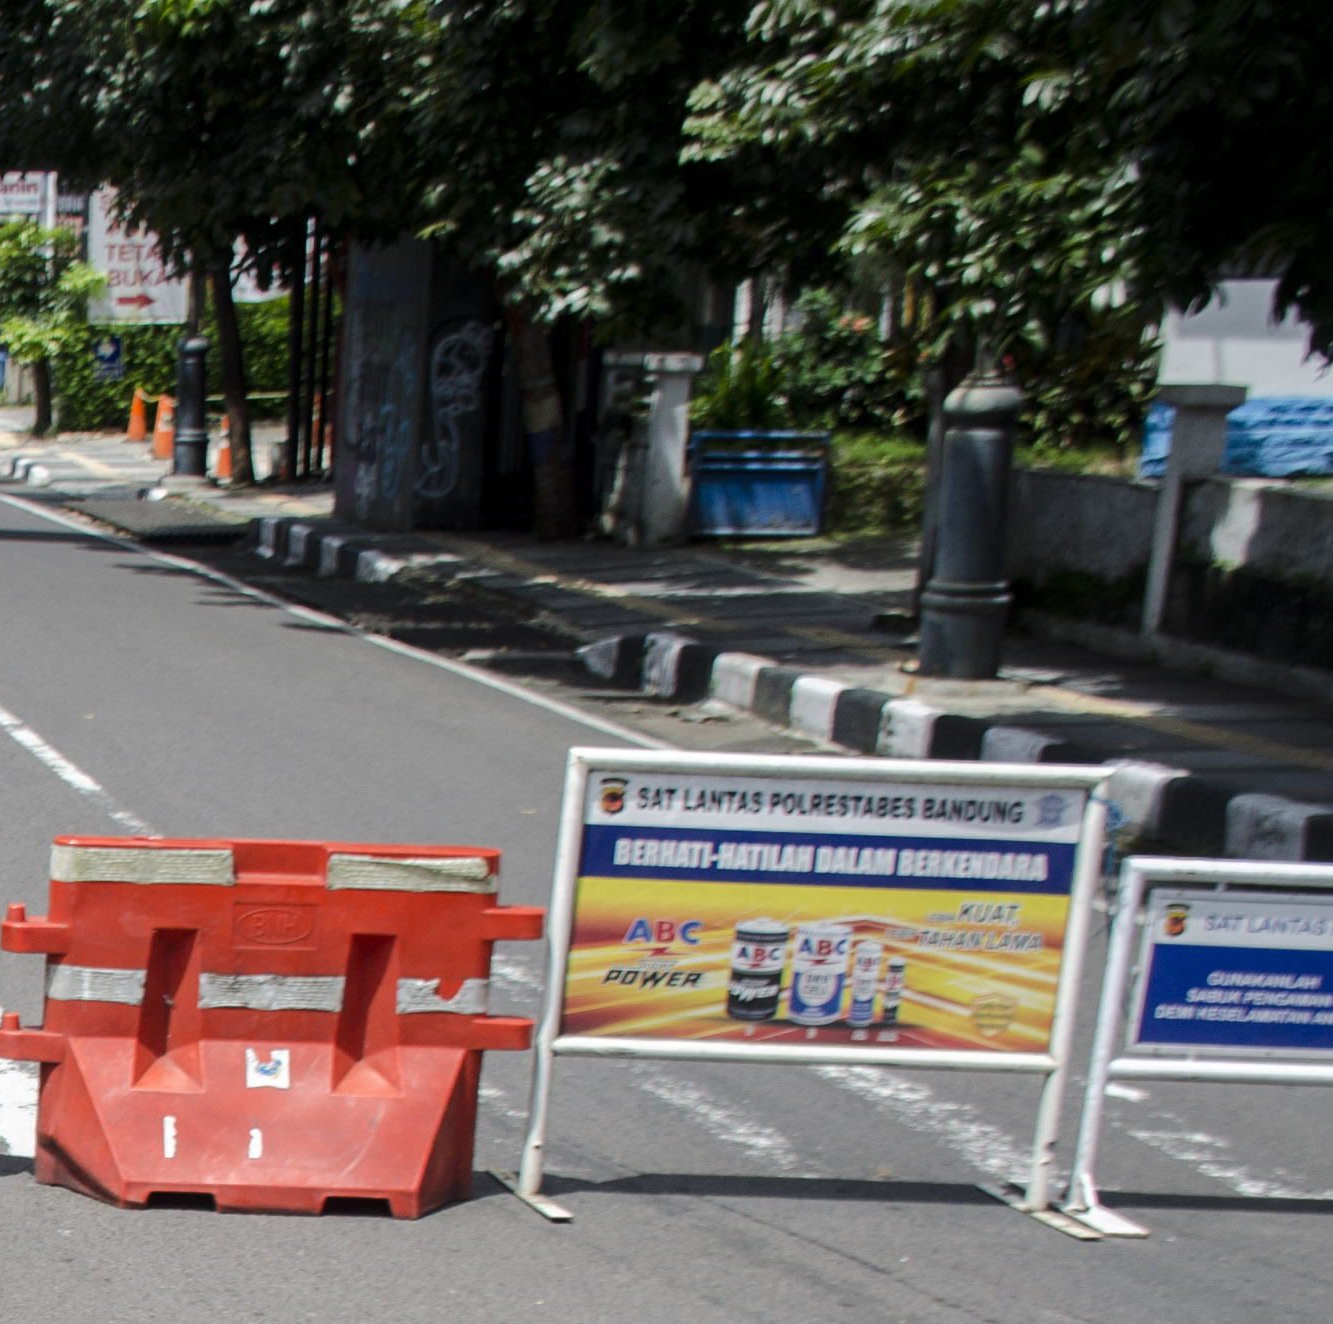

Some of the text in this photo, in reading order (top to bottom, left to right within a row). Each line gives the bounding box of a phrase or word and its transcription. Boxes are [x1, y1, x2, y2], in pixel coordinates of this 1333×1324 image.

[106, 243, 162, 263] TETA
[637, 786, 1023, 824] SAT LANTAS POLRESTABES BANDUNG
[613, 838, 1049, 882] BERHATI-HATILAH DALAM BERKENDARA
[956, 901, 1021, 929] KUAT,
[1203, 915, 1326, 937] SAT LANTAS
[622, 918, 703, 945] ABC
[916, 930, 983, 951] TAHAN
[983, 930, 1043, 952] LAMA
[736, 944, 783, 962] ABC
[798, 938, 848, 957] ABC
[602, 968, 704, 991] POWER
